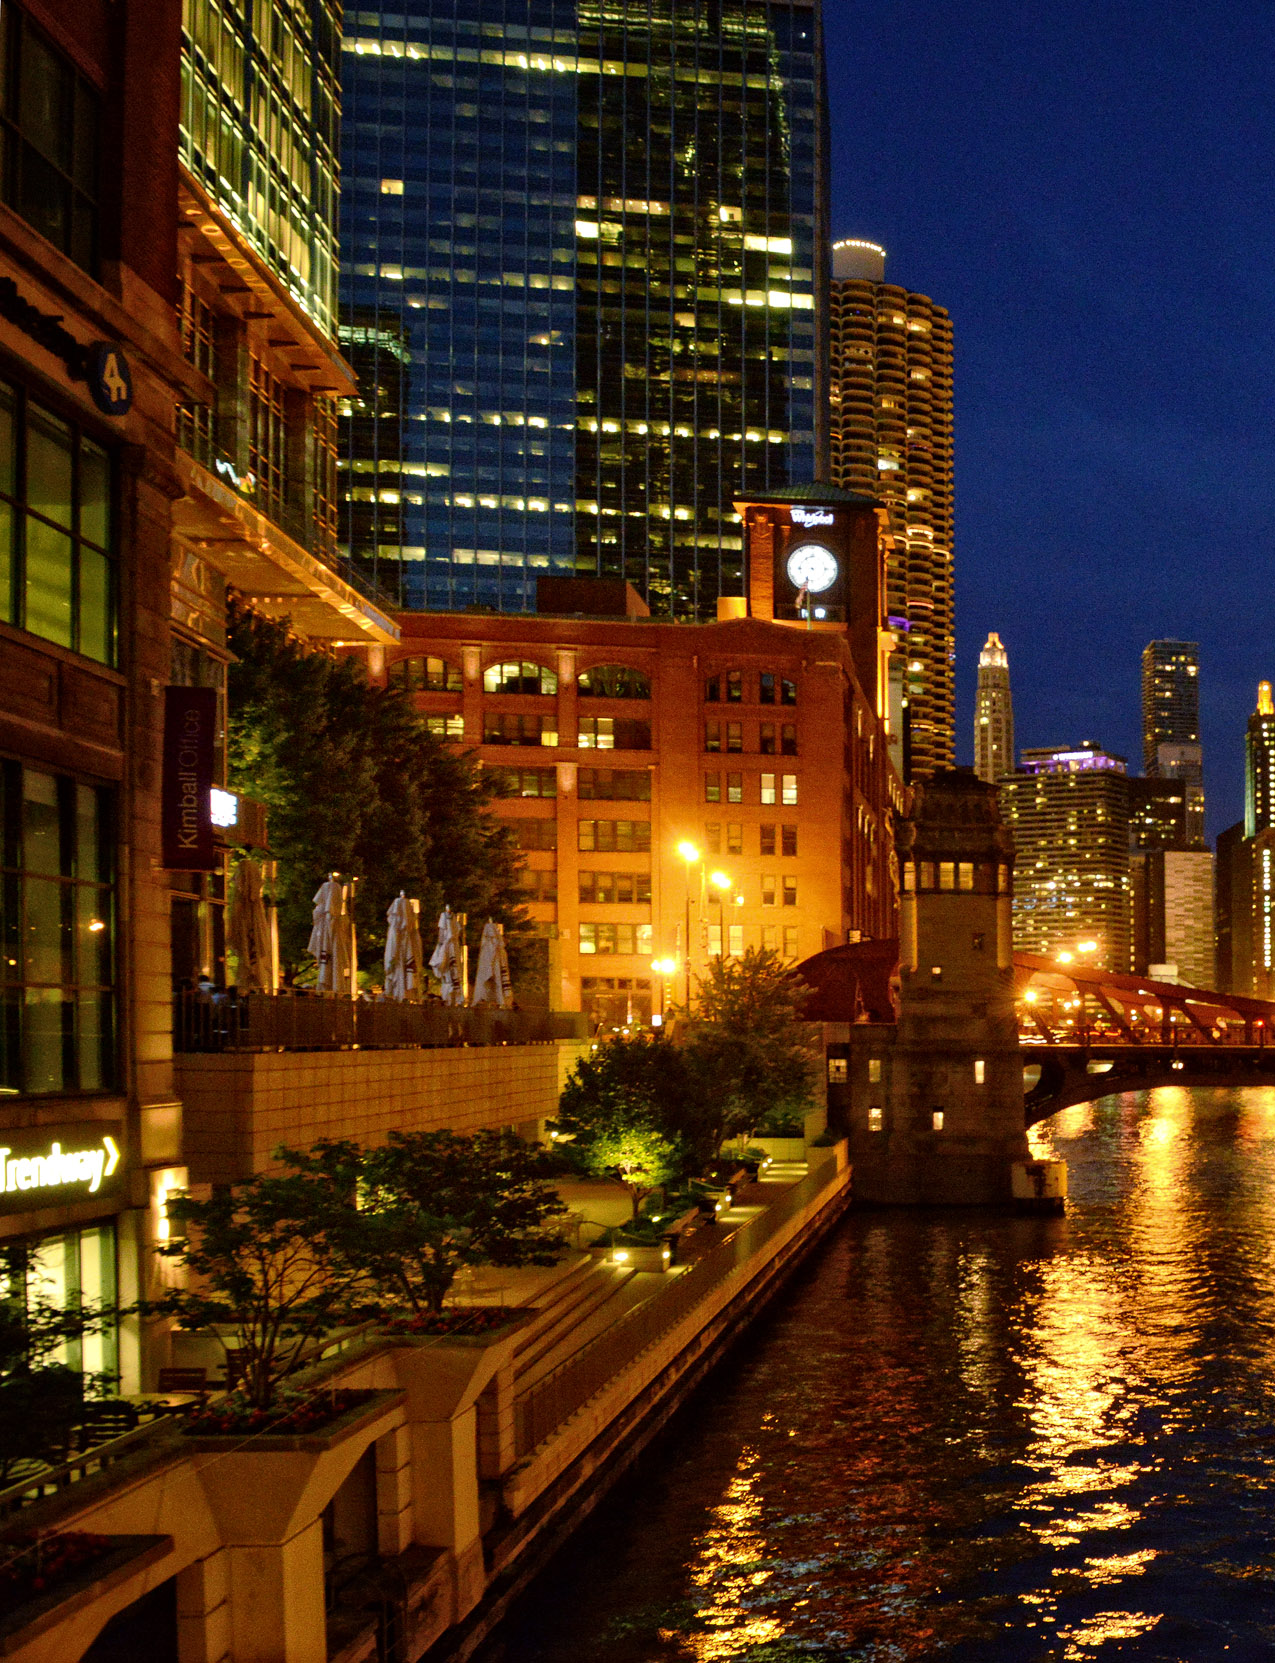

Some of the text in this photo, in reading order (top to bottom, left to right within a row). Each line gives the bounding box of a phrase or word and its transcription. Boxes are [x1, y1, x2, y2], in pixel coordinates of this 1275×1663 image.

[103, 352, 128, 403] 4
[177, 708, 201, 849] Kimball Office
[0, 1142, 105, 1193] Trendway
